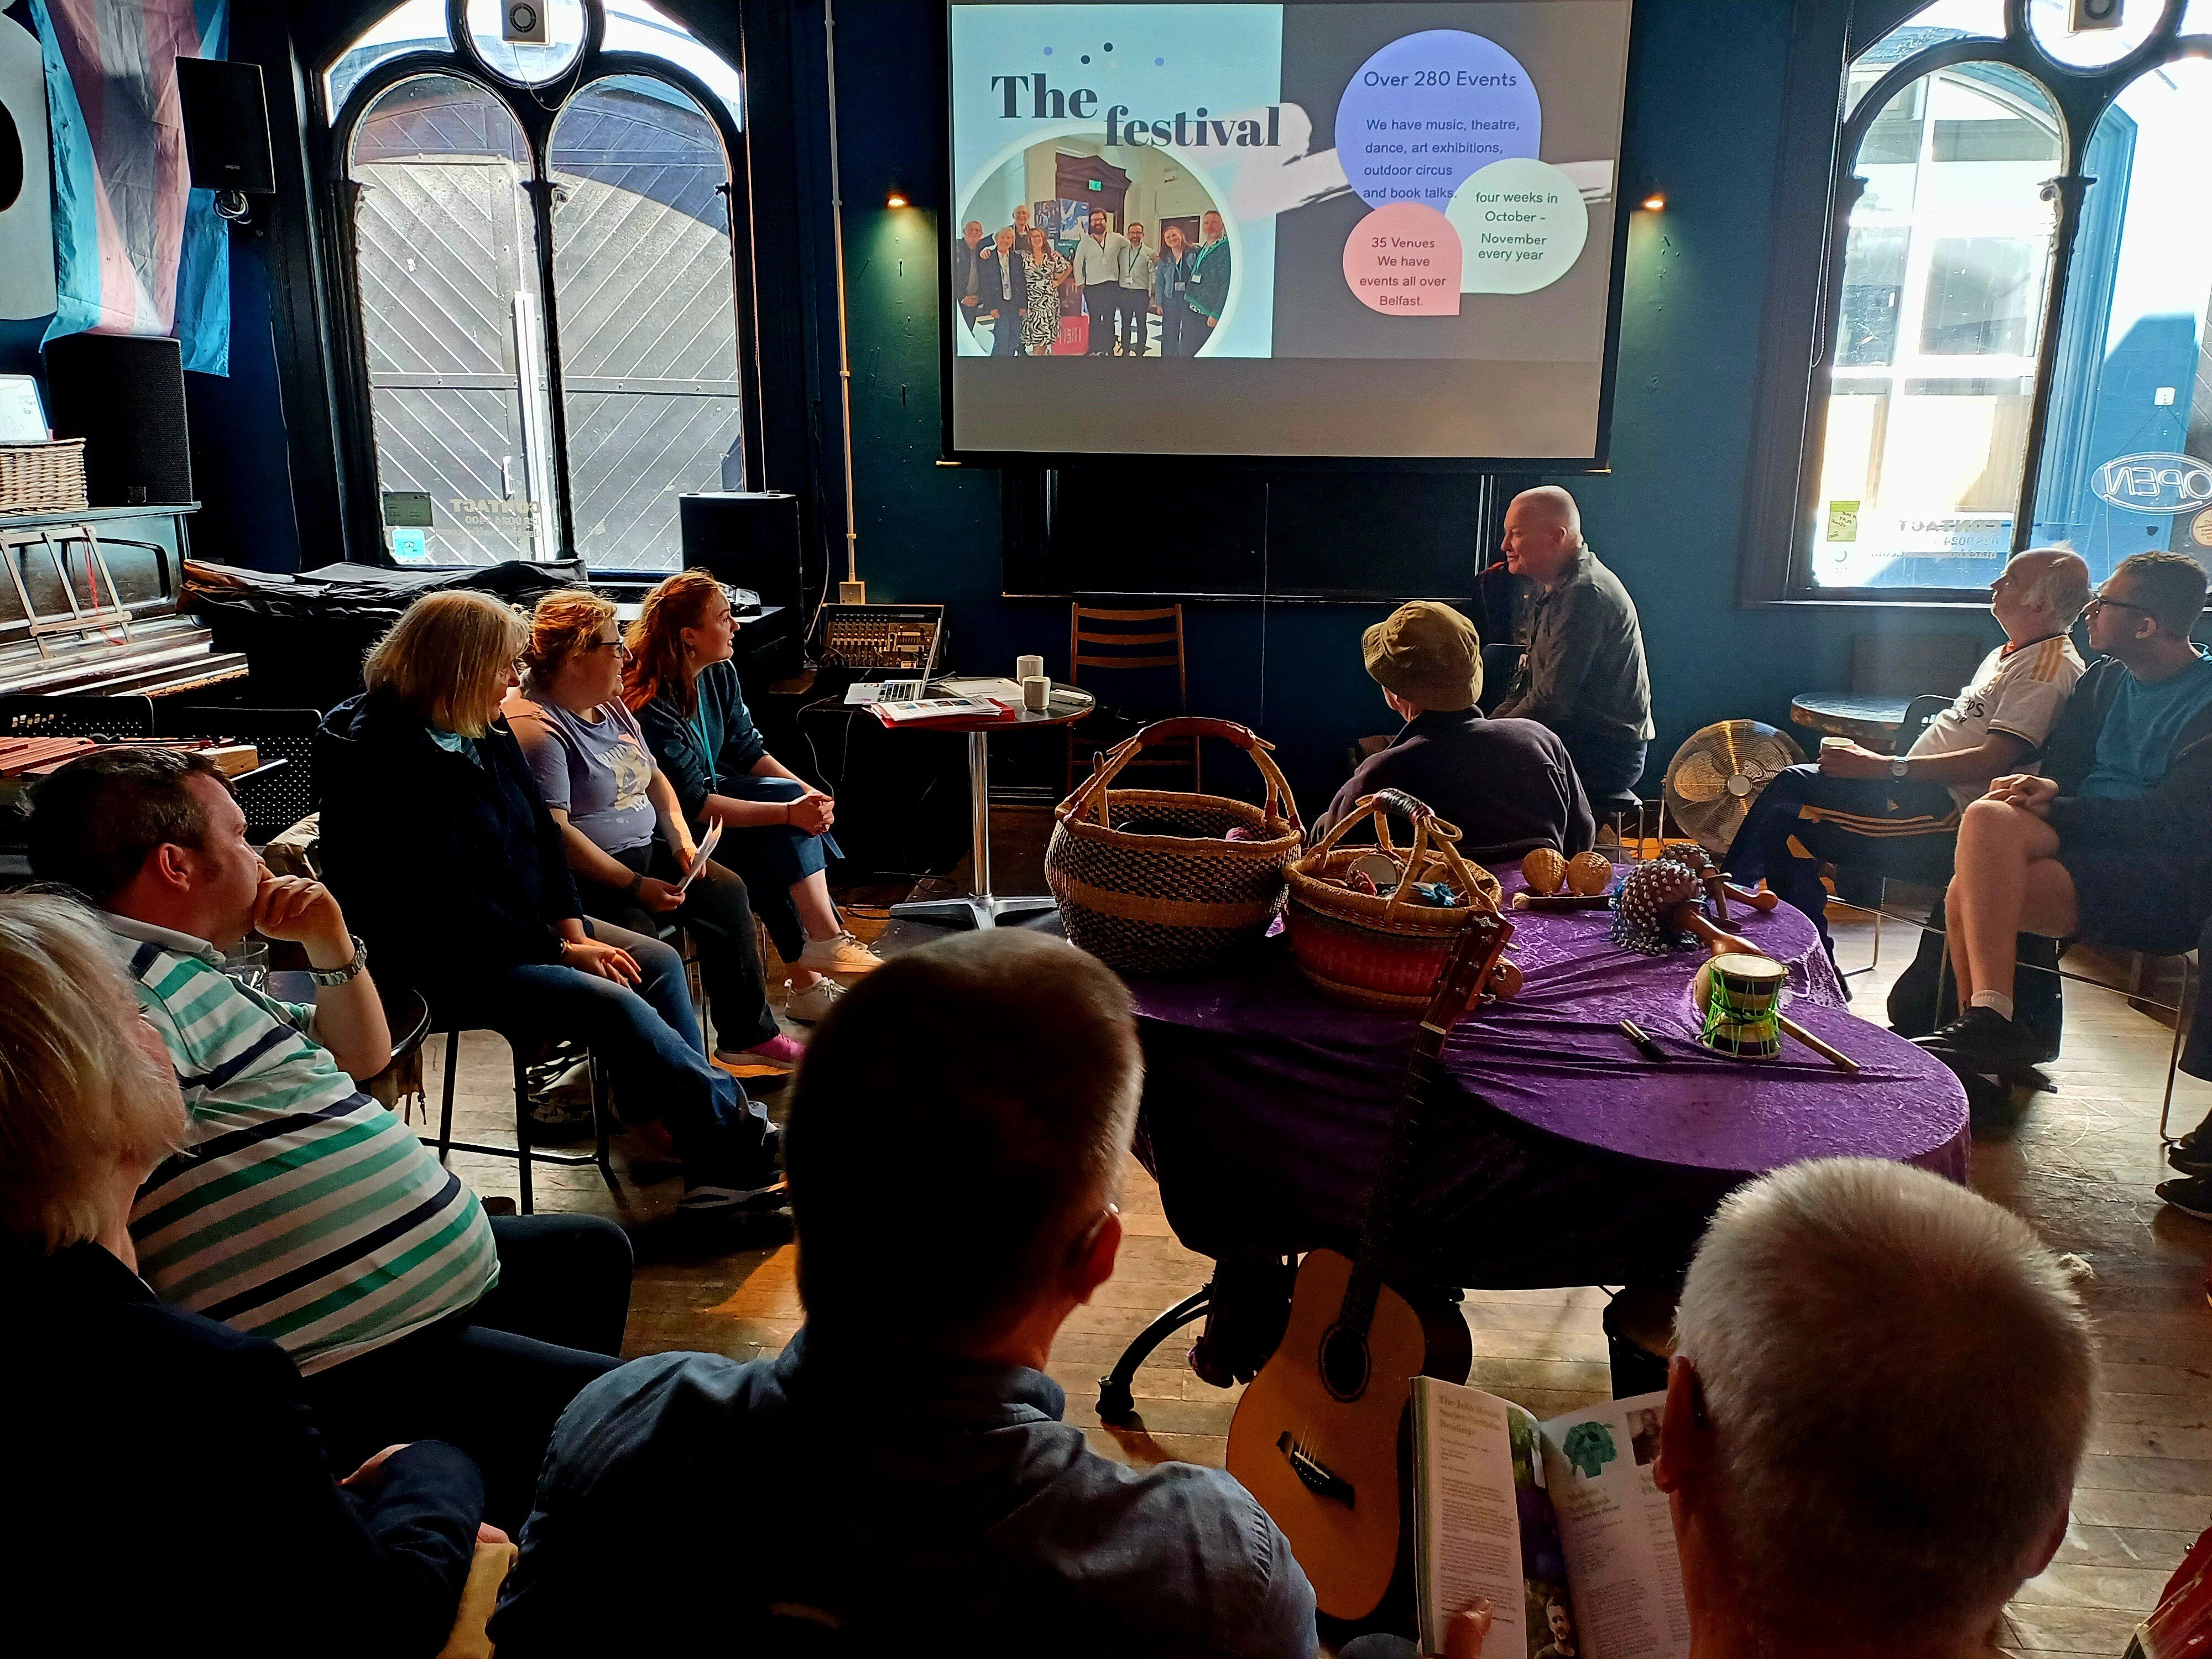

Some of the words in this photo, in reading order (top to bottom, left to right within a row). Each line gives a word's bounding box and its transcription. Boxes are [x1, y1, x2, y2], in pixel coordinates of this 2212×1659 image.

[1364, 71, 1409, 87] Over
[1414, 71, 1451, 86] 280
[1457, 70, 1516, 86] Events
[992, 72, 1098, 119] The
[1103, 105, 1281, 147] festival
[1366, 119, 1387, 131] We
[1391, 118, 1422, 130] have
[1426, 118, 1467, 132] music,
[1471, 119, 1519, 131] theatre,
[1365, 142, 1407, 155] dance,
[1411, 142, 1428, 153] art
[1432, 142, 1503, 154] exhibitions,
[1364, 164, 1412, 175] outdoor
[1416, 164, 1453, 175] circus
[1363, 187, 1387, 199] and
[1390, 187, 1421, 199] book
[1425, 187, 1457, 199] talks.
[1475, 192, 1501, 203] four
[1503, 192, 1543, 203] weeks
[1547, 192, 1558, 204] in
[1485, 210, 1537, 222] October
[1371, 237, 1387, 248] 35
[1391, 237, 1435, 248] Venues
[1481, 232, 1547, 245] November
[1378, 255, 1397, 267] We
[1401, 256, 1430, 267] have
[1478, 249, 1513, 262] every
[1515, 250, 1544, 263] year
[1360, 276, 1399, 286] events
[1402, 276, 1416, 286] all
[1419, 277, 1447, 287] over
[1380, 295, 1423, 306] Belfast.
